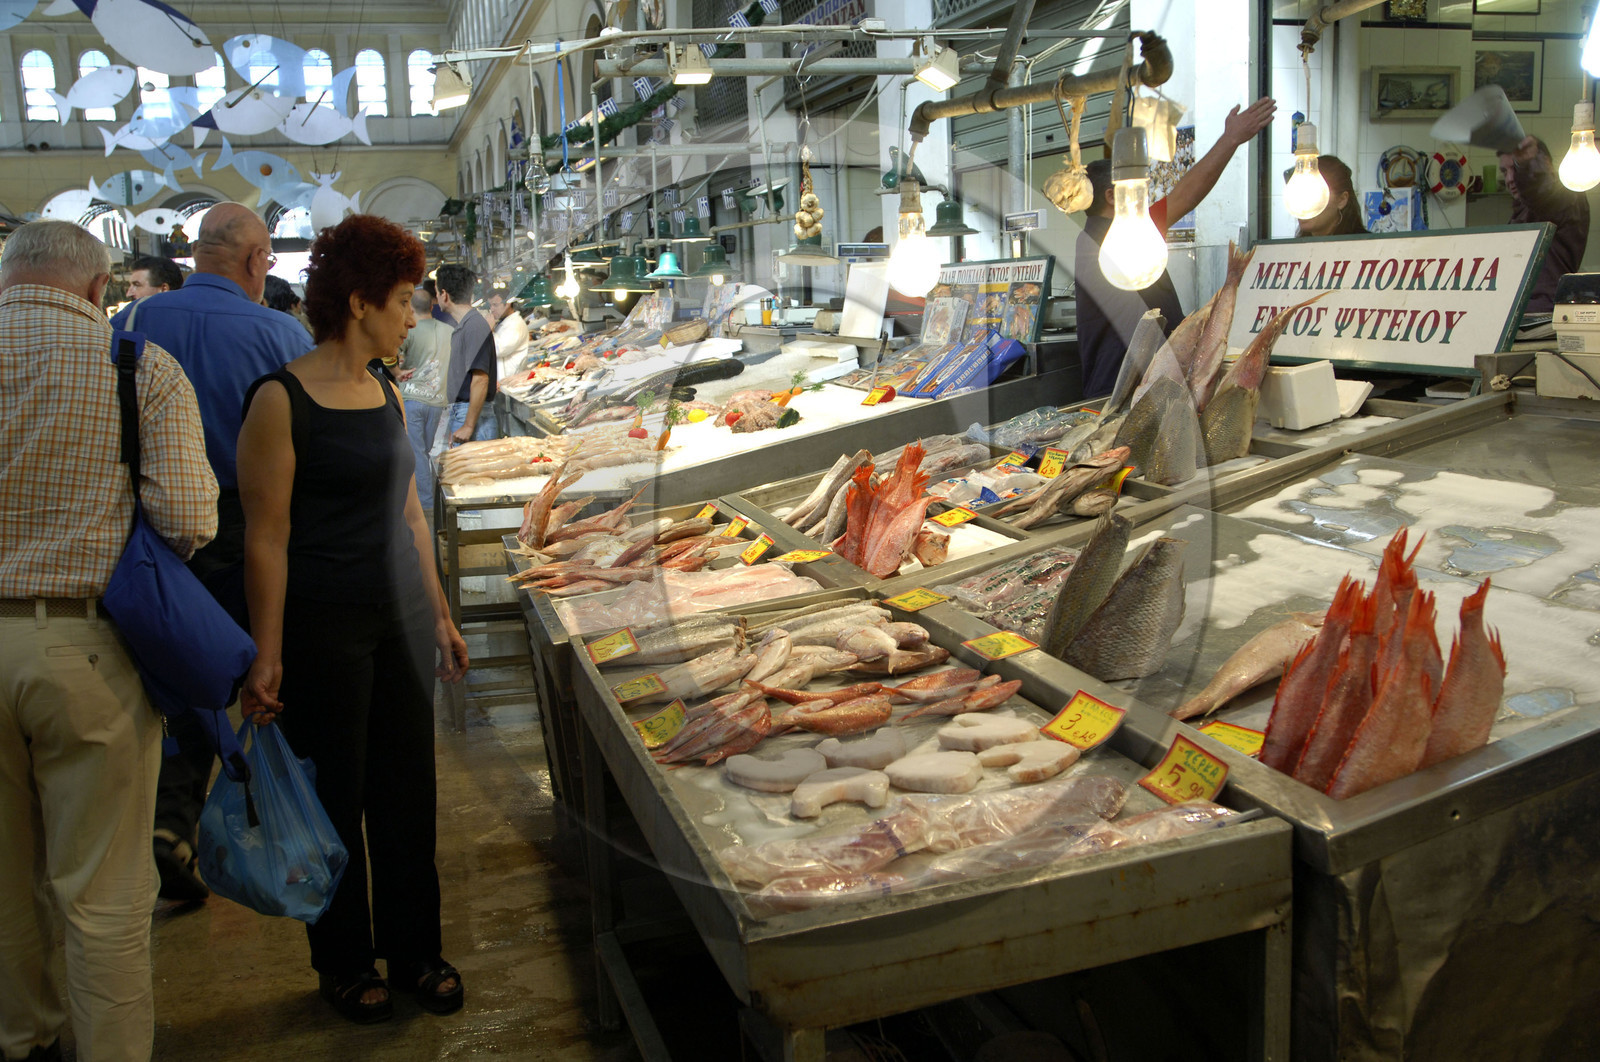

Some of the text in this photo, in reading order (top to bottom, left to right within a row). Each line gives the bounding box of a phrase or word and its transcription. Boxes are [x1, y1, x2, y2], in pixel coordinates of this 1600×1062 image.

[1250, 257, 1500, 291] ΜΕΓΑΛΗ ΠΟΙΚΙΛΙΑ
[1334, 307, 1467, 344] ΨΥΓΕΙΟΥ
[1060, 713, 1082, 730] 3
[1168, 763, 1186, 787] 5
